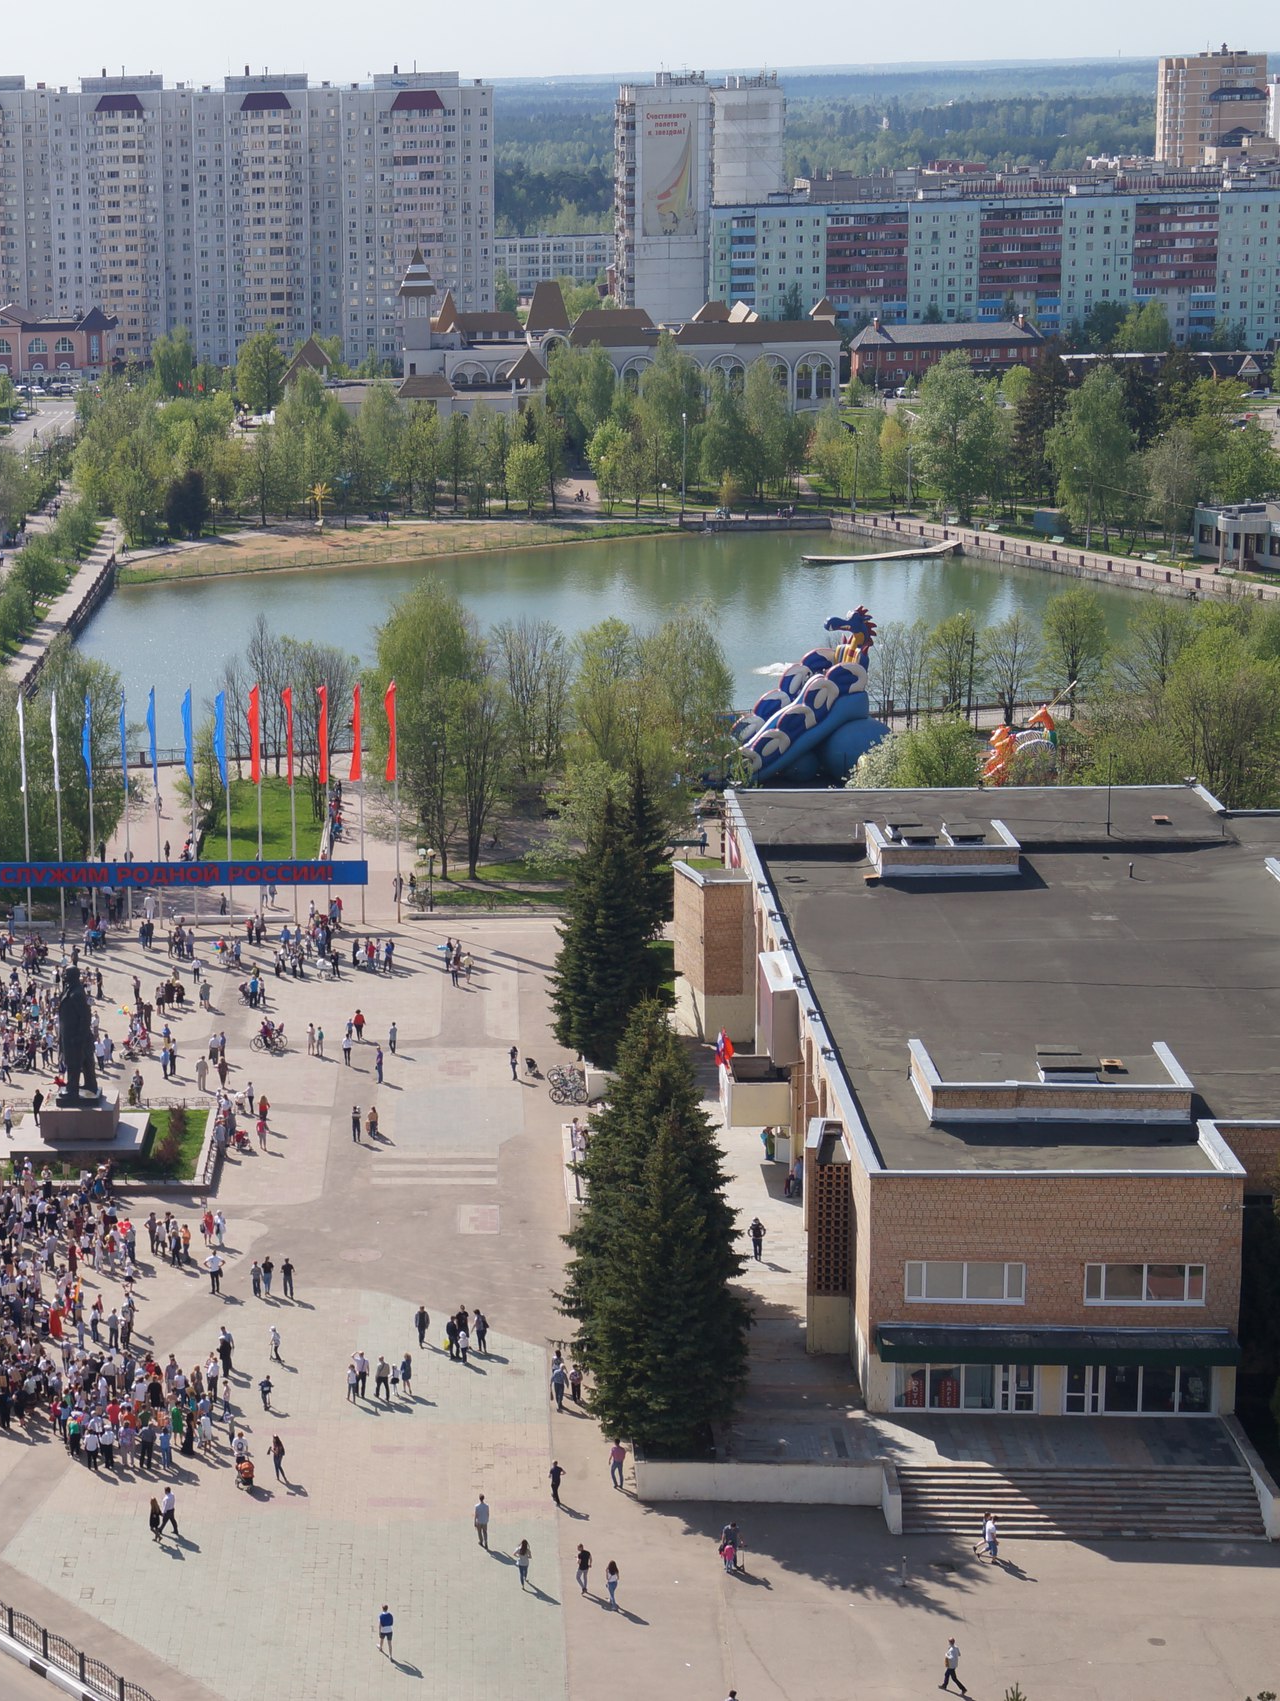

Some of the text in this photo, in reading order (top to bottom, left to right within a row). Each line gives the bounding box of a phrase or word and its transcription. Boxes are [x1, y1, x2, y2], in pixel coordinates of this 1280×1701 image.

[646, 112, 687, 120] Счастливого
[0, 863, 334, 887] СЛУЖИМ РОДНОЙ РОССИИ!
